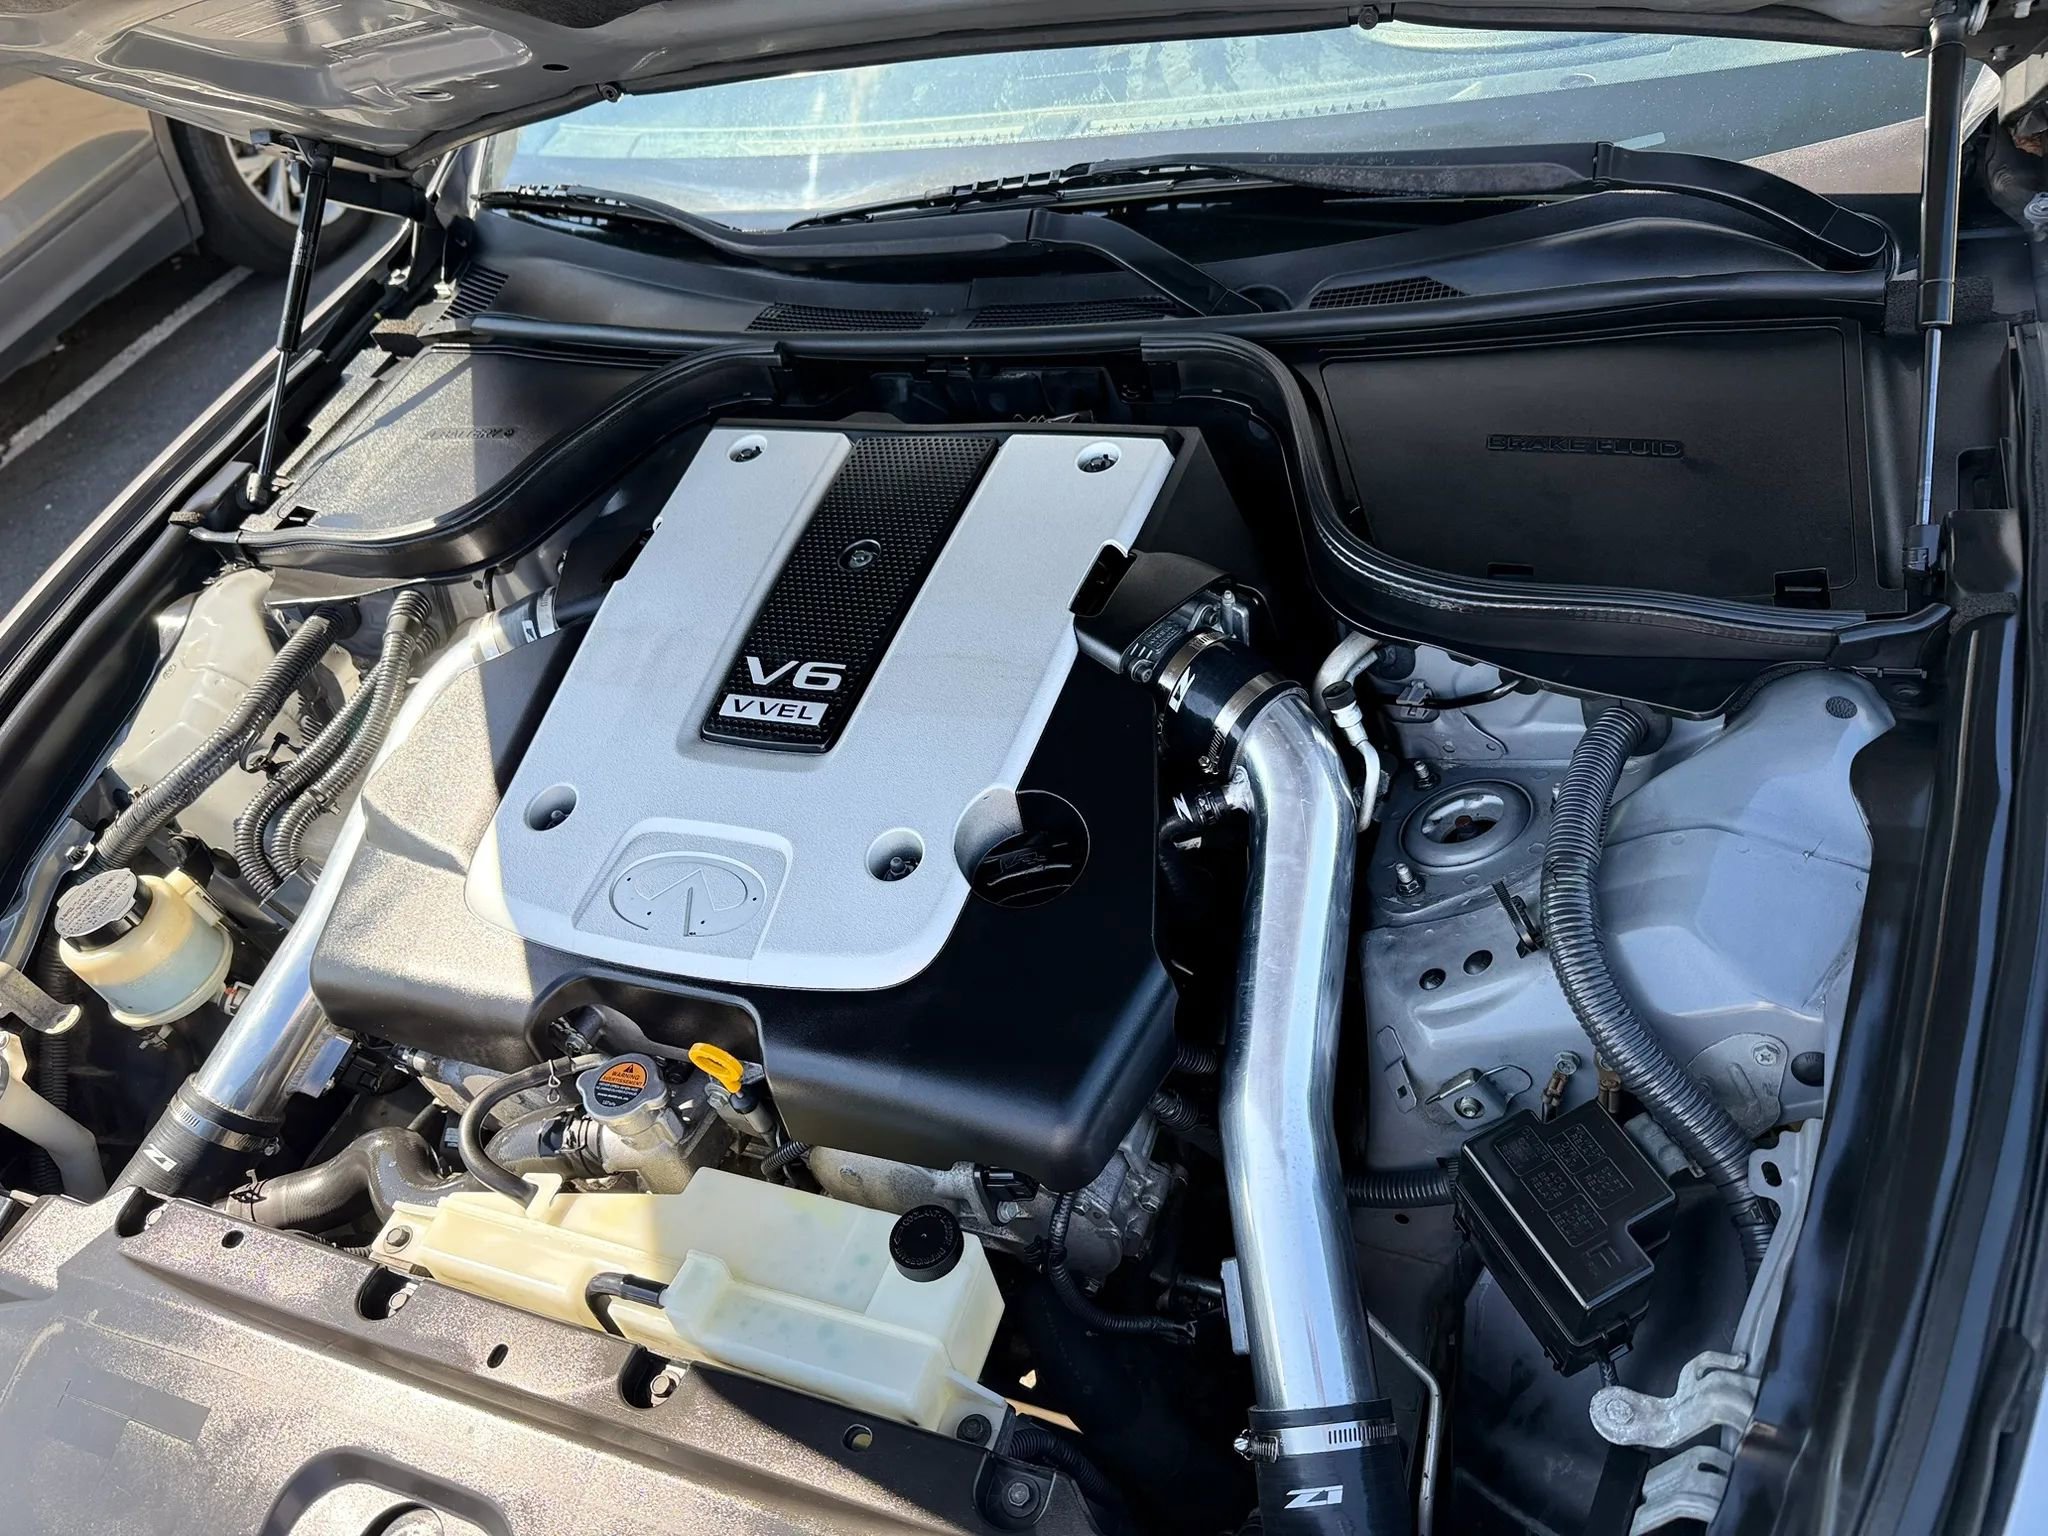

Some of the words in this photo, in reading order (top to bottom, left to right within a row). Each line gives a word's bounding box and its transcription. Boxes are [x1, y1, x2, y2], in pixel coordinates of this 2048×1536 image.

[1487, 435, 1585, 452] BRAKE
[1595, 440, 1682, 456] FLUID
[745, 656, 847, 691] V6
[734, 698, 813, 720] VVEL
[611, 1070, 641, 1080] WARNING
[1284, 1484, 1344, 1509] Z1
